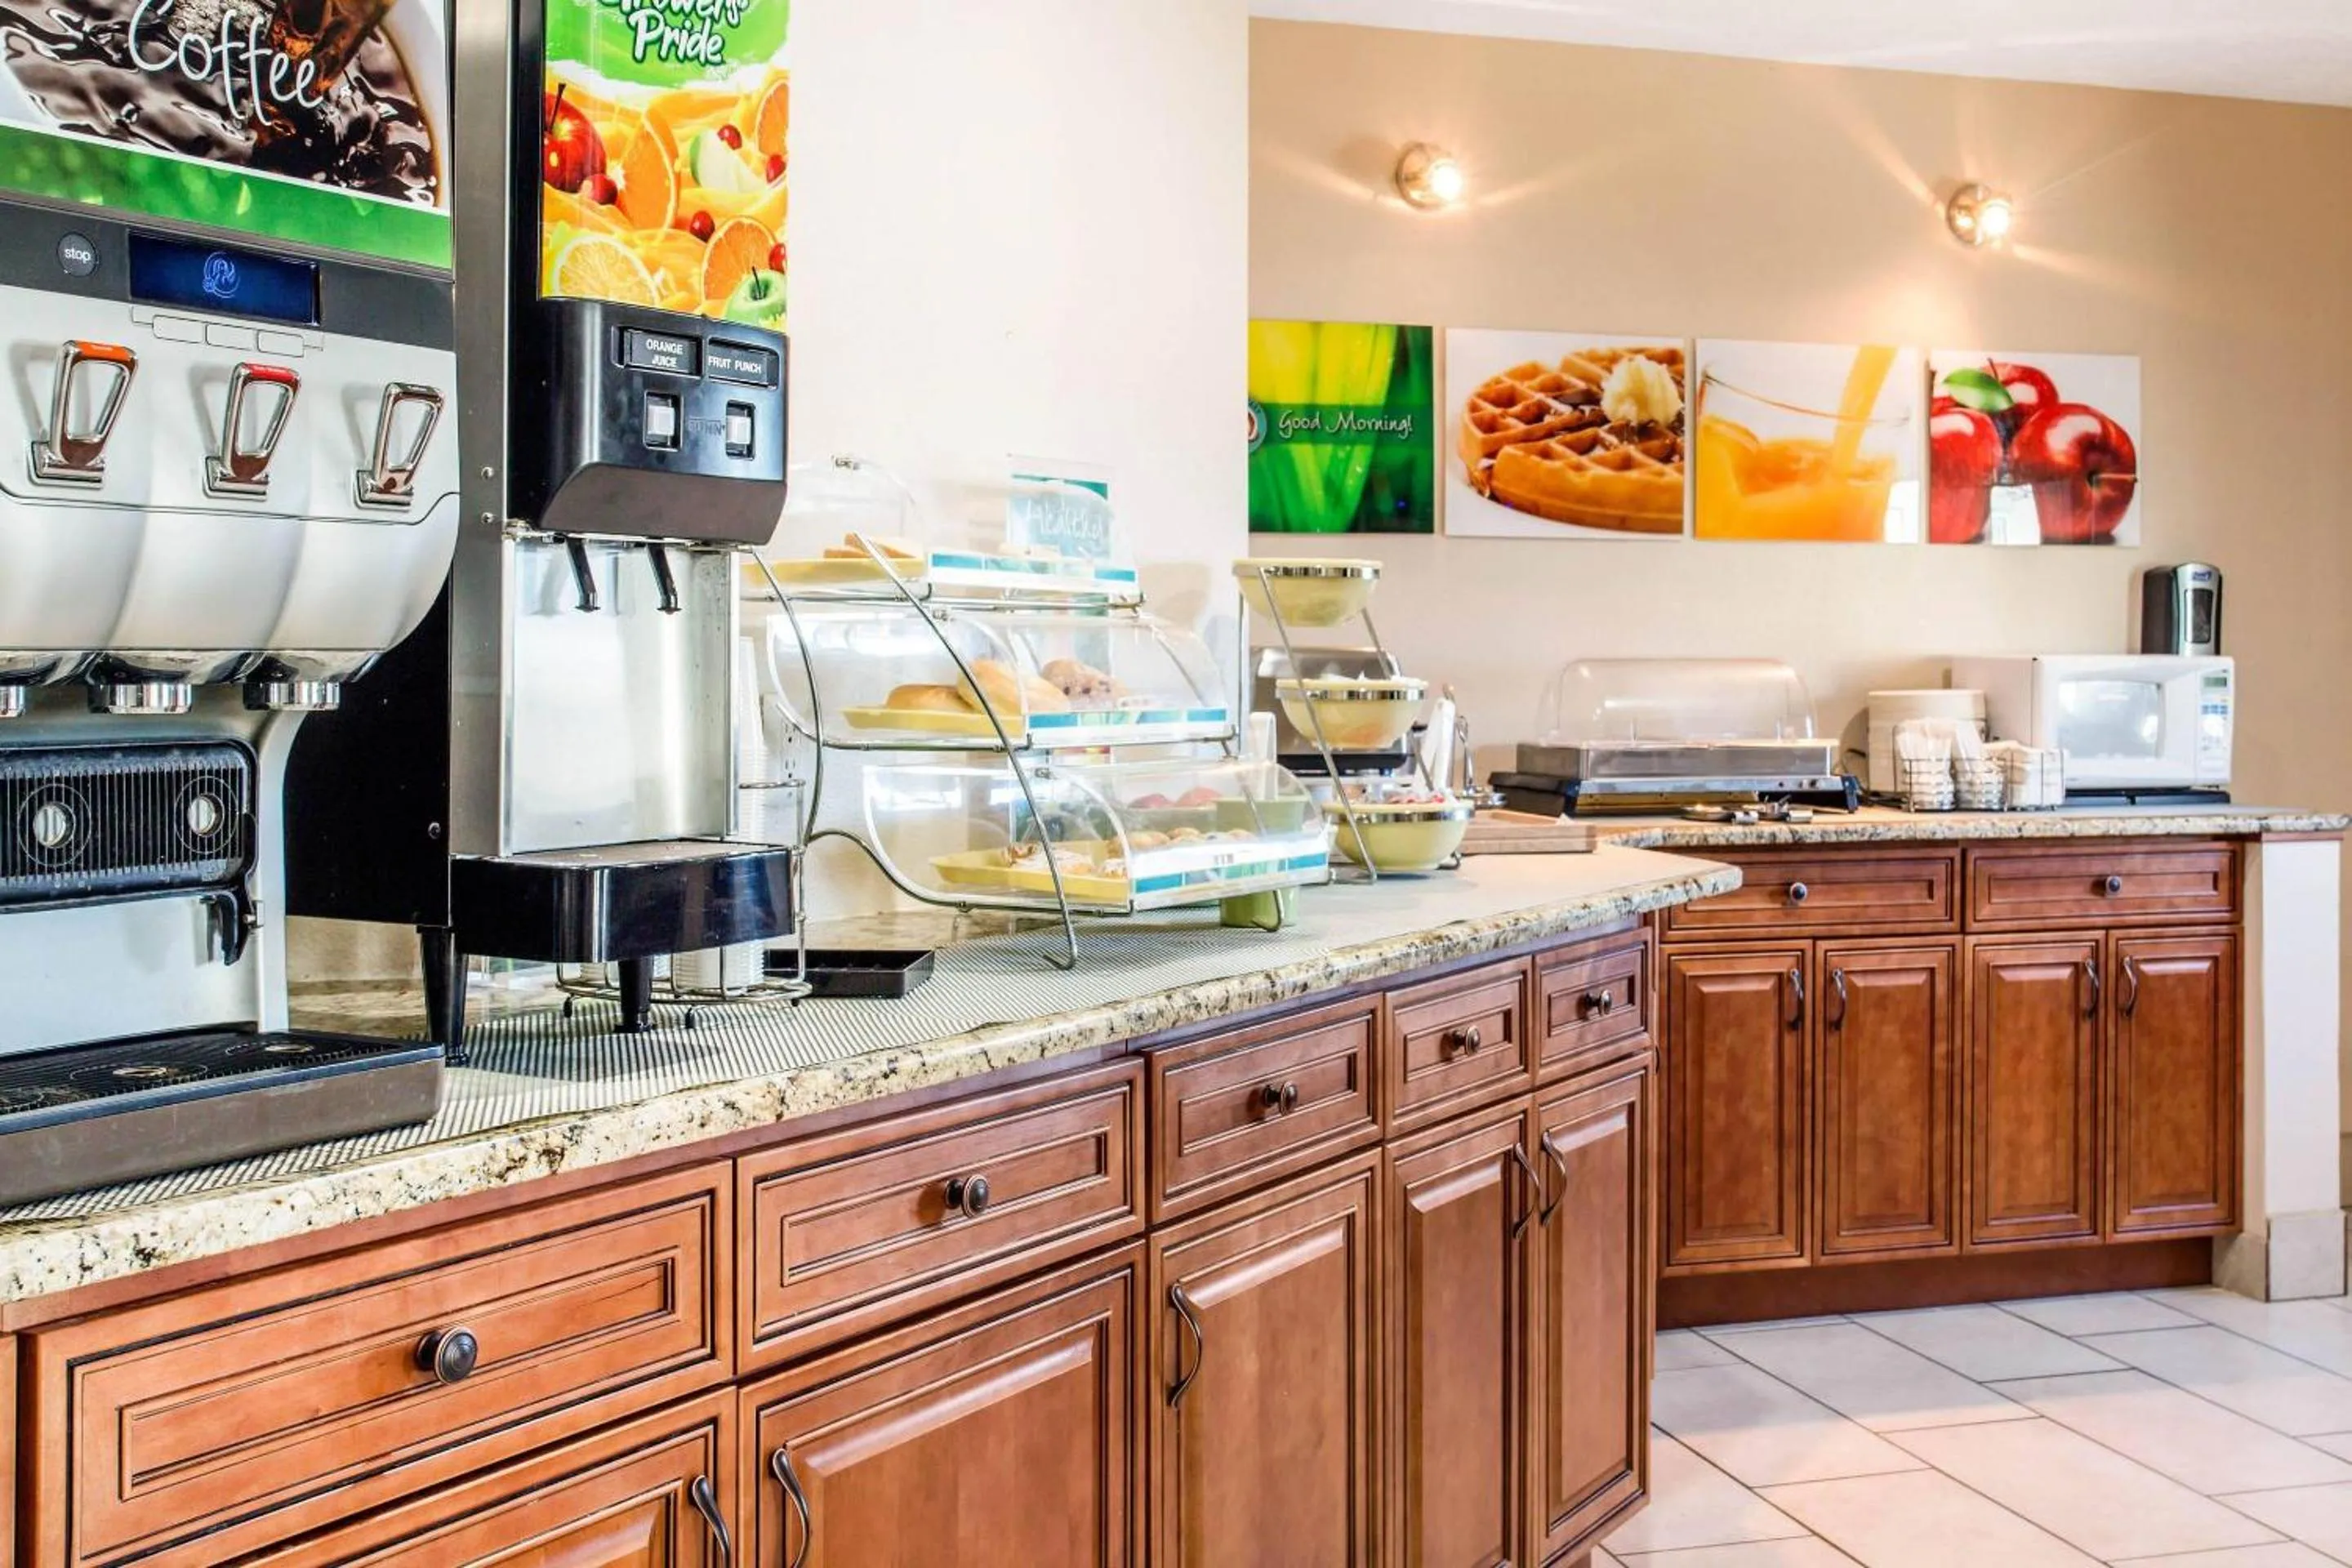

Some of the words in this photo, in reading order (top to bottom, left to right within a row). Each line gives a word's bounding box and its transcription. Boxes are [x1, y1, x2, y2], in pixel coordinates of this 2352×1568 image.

[628, 7, 723, 65] Pride
[127, 0, 324, 127] Coffee
[65, 247, 91, 265] stop
[646, 338, 684, 354] ORANGE
[652, 354, 677, 368] JUICE
[708, 355, 732, 369] FRUIT
[734, 359, 762, 373] PUNCH
[1279, 409, 1321, 439] Good
[1326, 412, 1414, 439] Morning!
